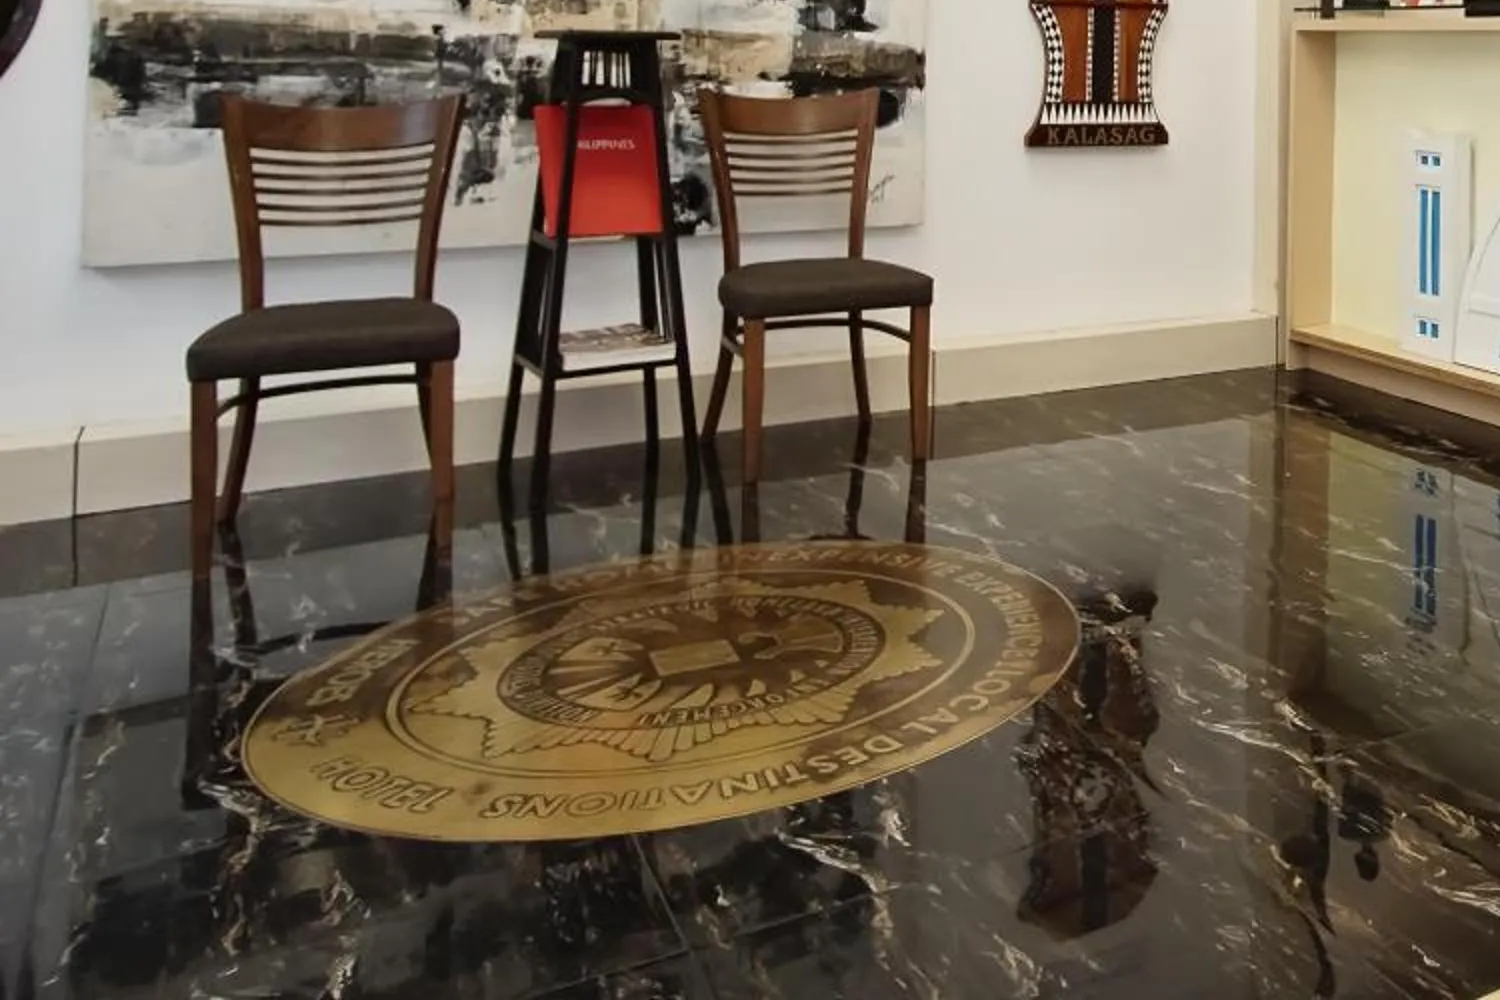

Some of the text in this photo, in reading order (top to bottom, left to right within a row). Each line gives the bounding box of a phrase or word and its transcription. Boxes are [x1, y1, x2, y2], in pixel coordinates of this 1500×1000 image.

[1047, 126, 1157, 145] KALASAG
[901, 665, 1025, 735] LOCAL
[309, 754, 455, 814] HOTEL
[479, 734, 904, 820] DESTINATIONS
